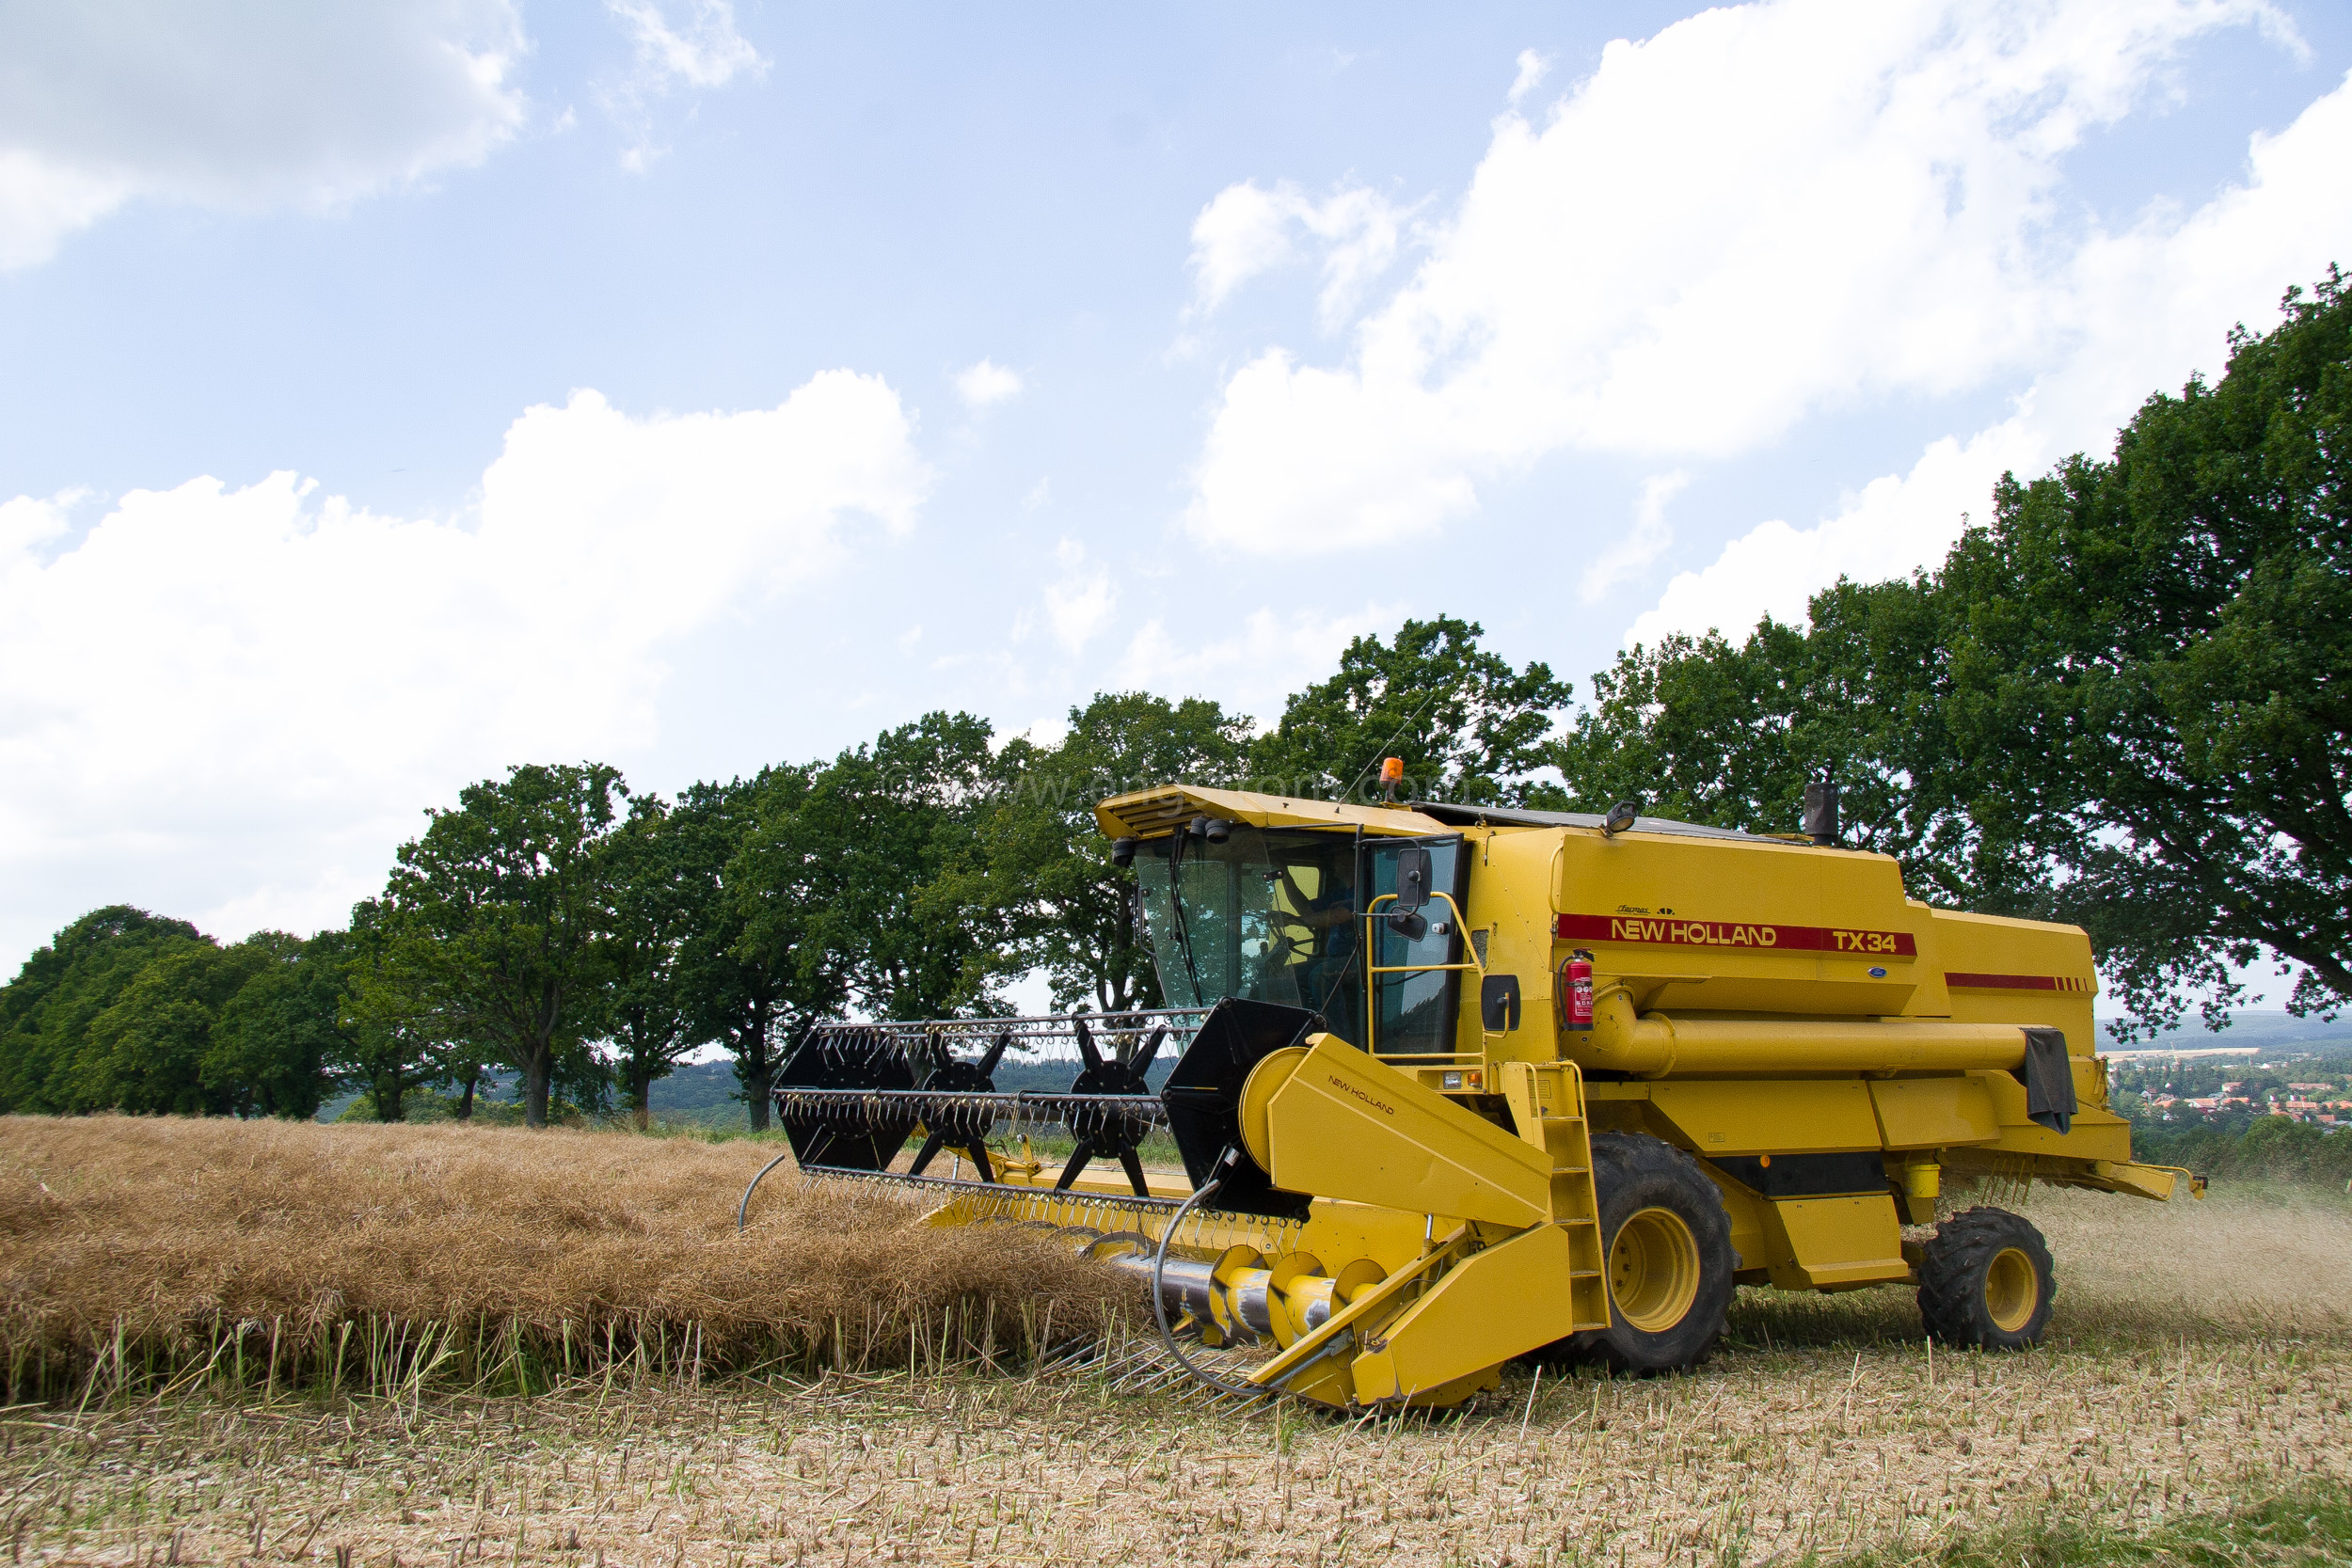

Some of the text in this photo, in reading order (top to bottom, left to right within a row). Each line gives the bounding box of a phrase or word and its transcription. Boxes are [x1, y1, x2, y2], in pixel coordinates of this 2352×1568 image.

[1612, 919, 1776, 946] NEW HOLLAND
[1833, 930, 1897, 953] TX34
[1328, 1075, 1394, 1115] NEW HOLLAND
